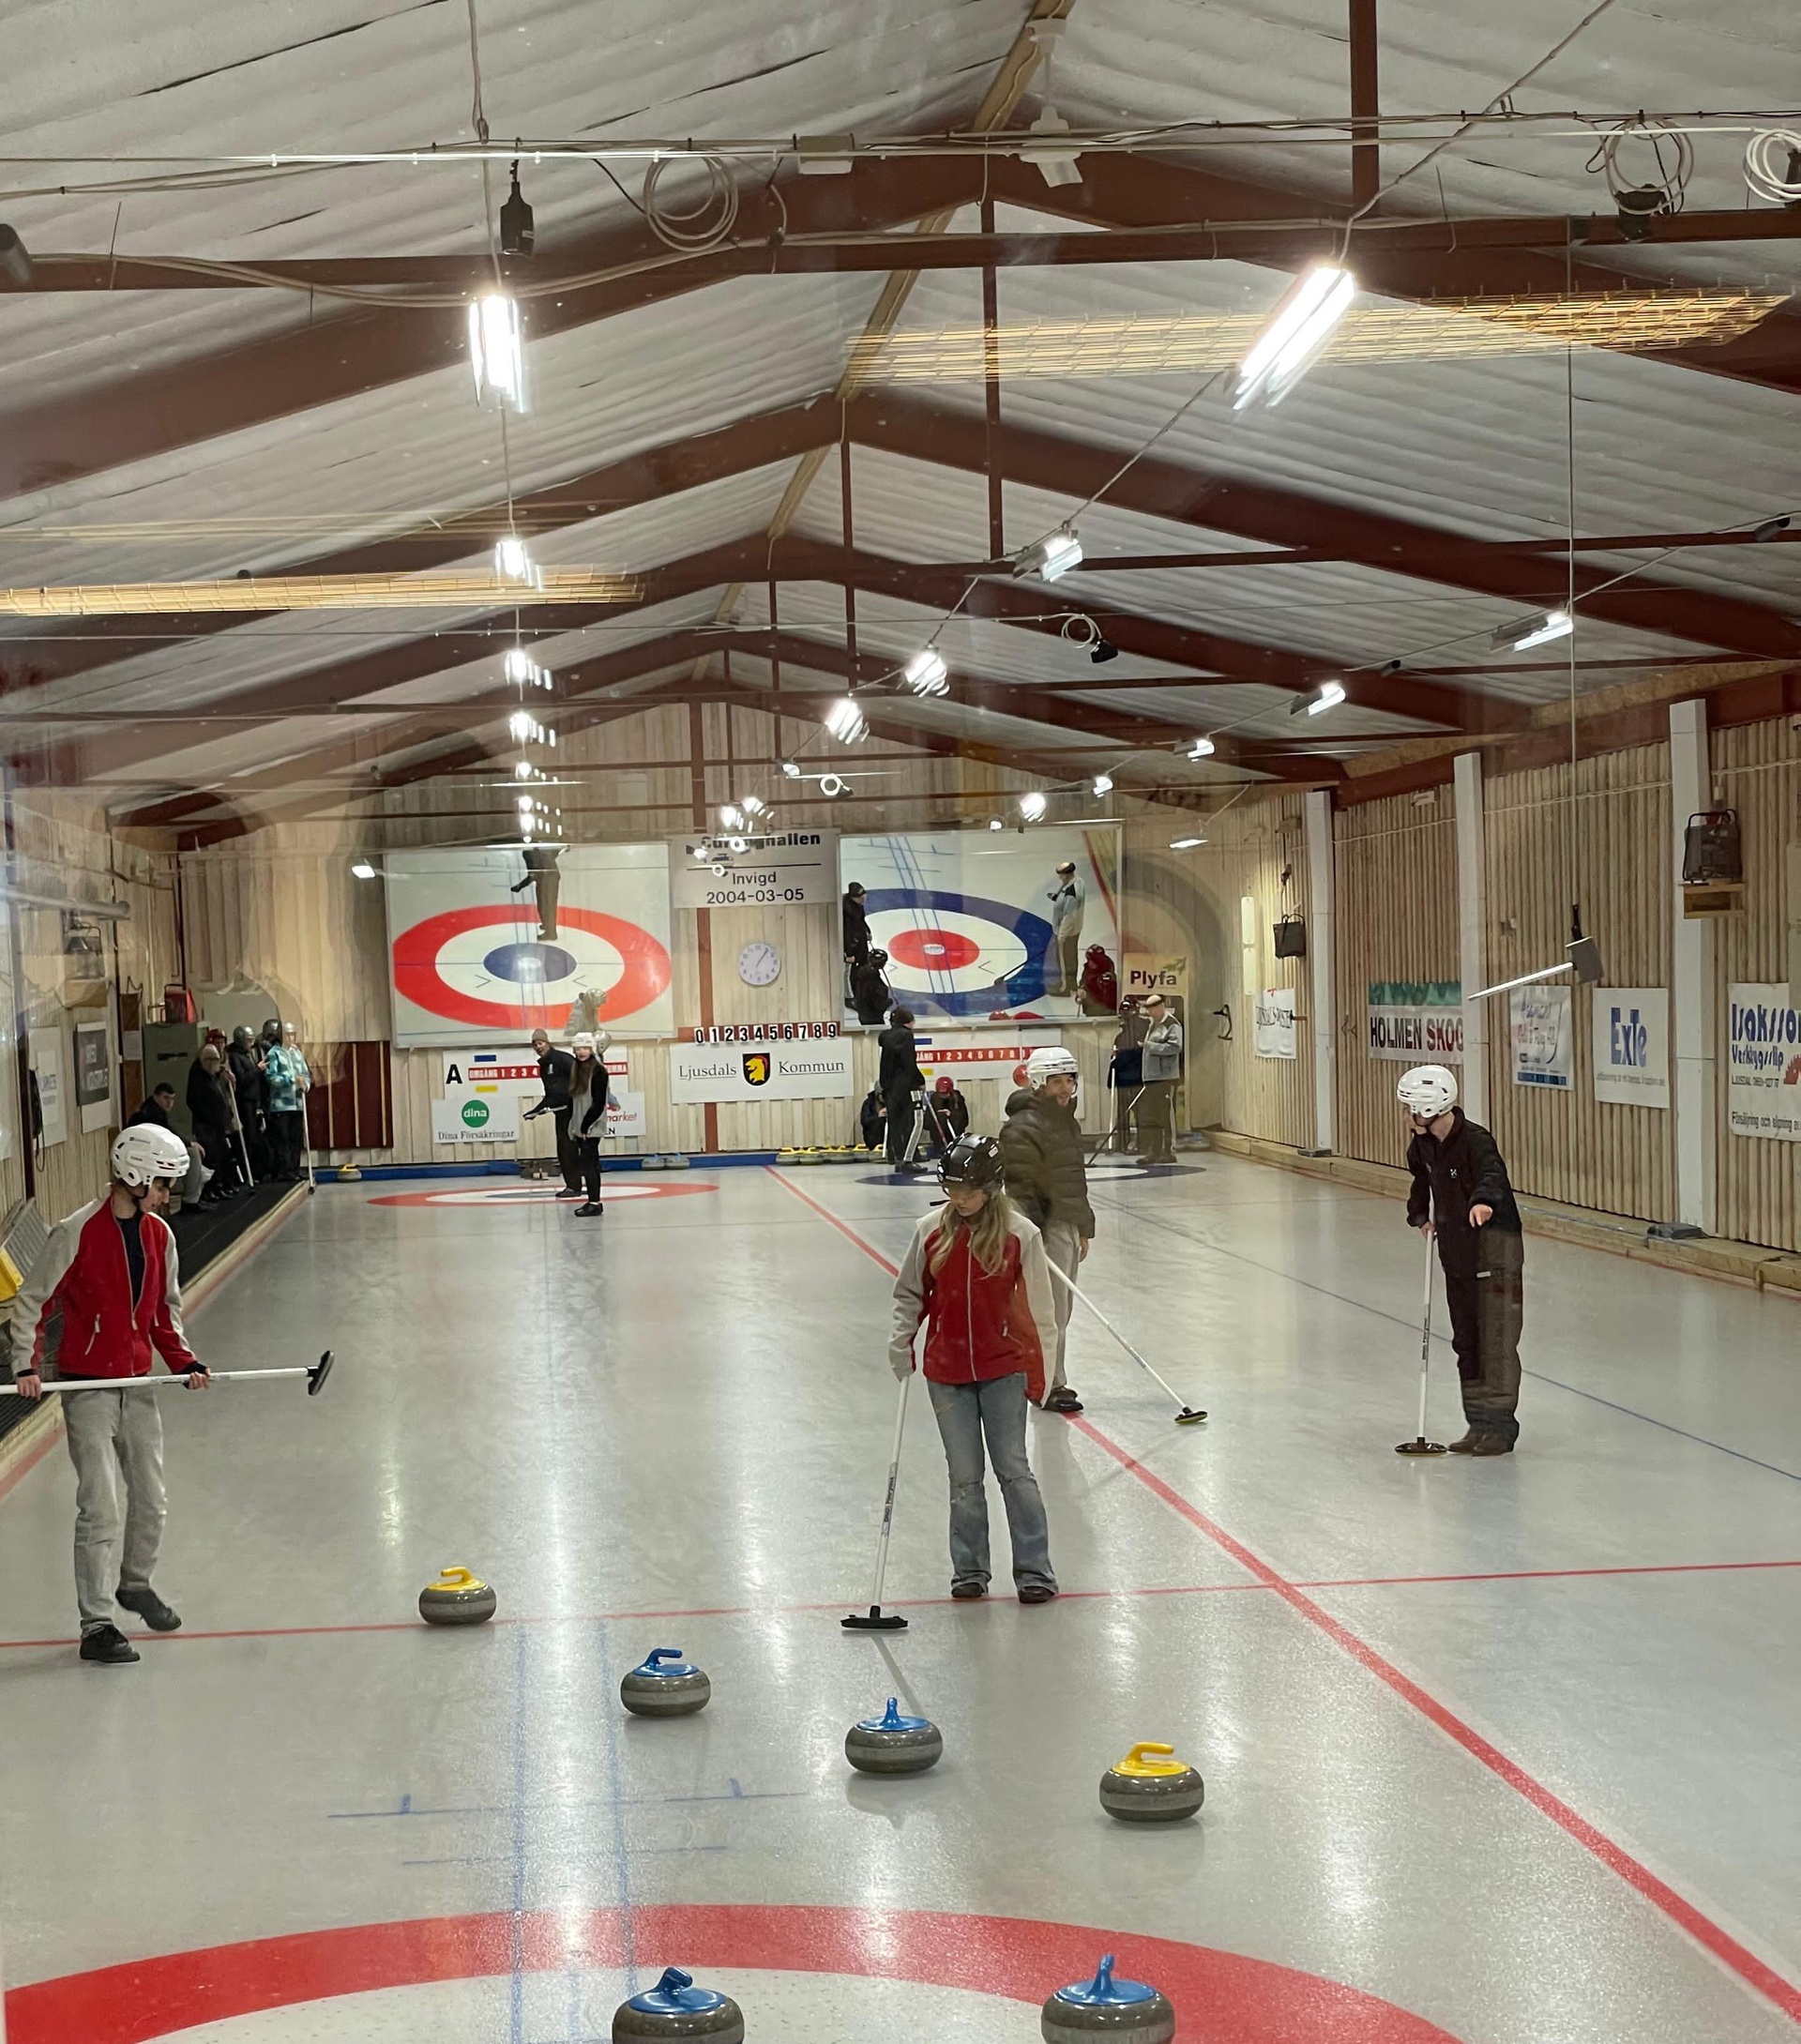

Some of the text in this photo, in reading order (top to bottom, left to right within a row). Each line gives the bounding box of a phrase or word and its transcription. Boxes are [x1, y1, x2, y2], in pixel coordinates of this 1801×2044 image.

[733, 871, 777, 886] Invigd
[706, 888, 804, 904] 2004-03-05
[1130, 970, 1177, 989] Plyfa
[1370, 1017, 1422, 1050] HOLMEN
[446, 1064, 462, 1084] A
[678, 1061, 844, 1081] Ljusdals Kommun
[463, 1108, 487, 1118] dina
[438, 1129, 515, 1140] Dina Försäkringar
